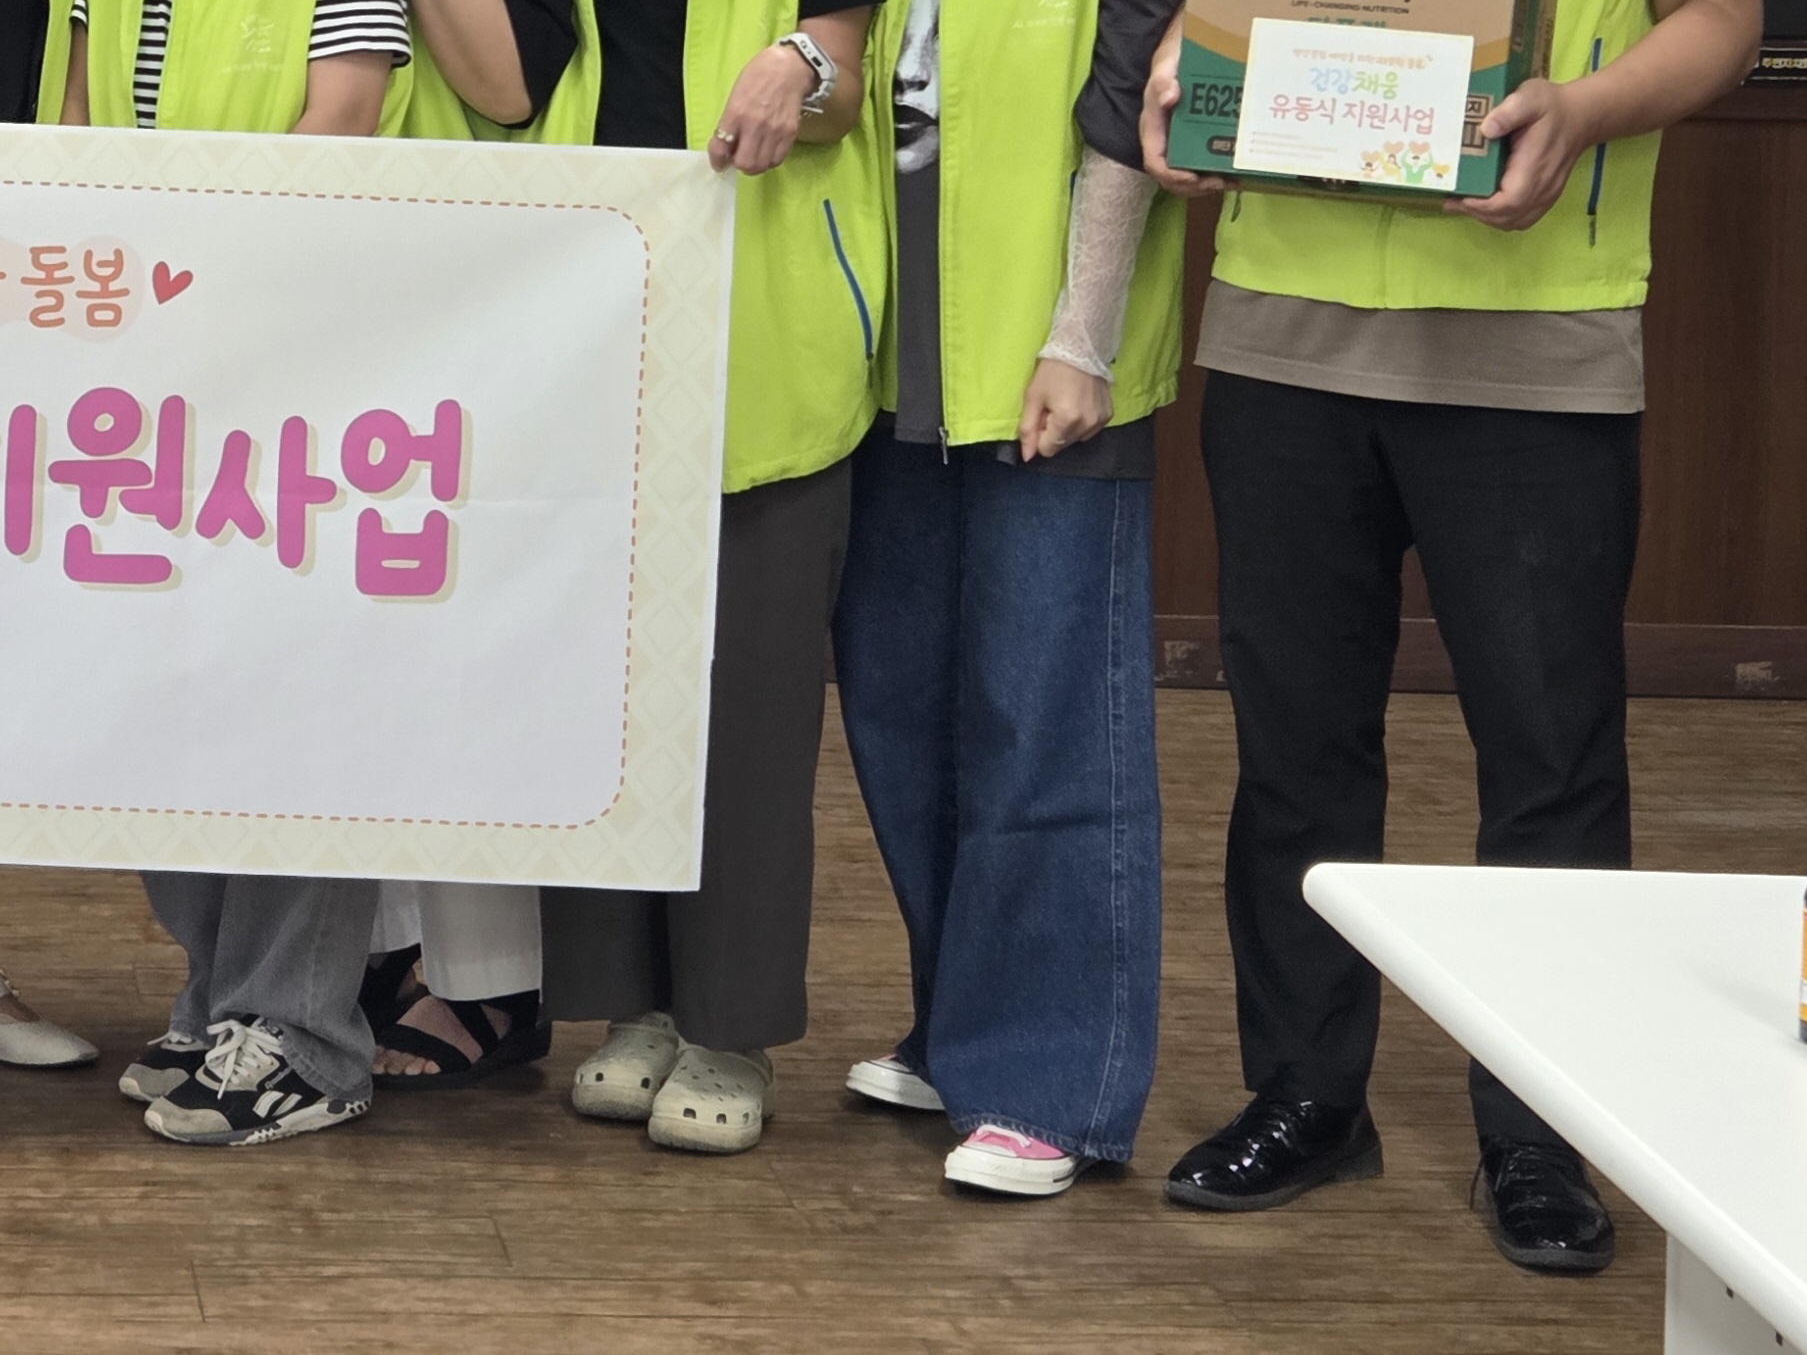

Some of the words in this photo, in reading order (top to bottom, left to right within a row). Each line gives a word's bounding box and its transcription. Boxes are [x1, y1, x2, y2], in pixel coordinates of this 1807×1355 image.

[1269, 93, 1337, 125] 유동식
[1342, 99, 1435, 135] 지원사업
[19, 245, 131, 328] 돌봄
